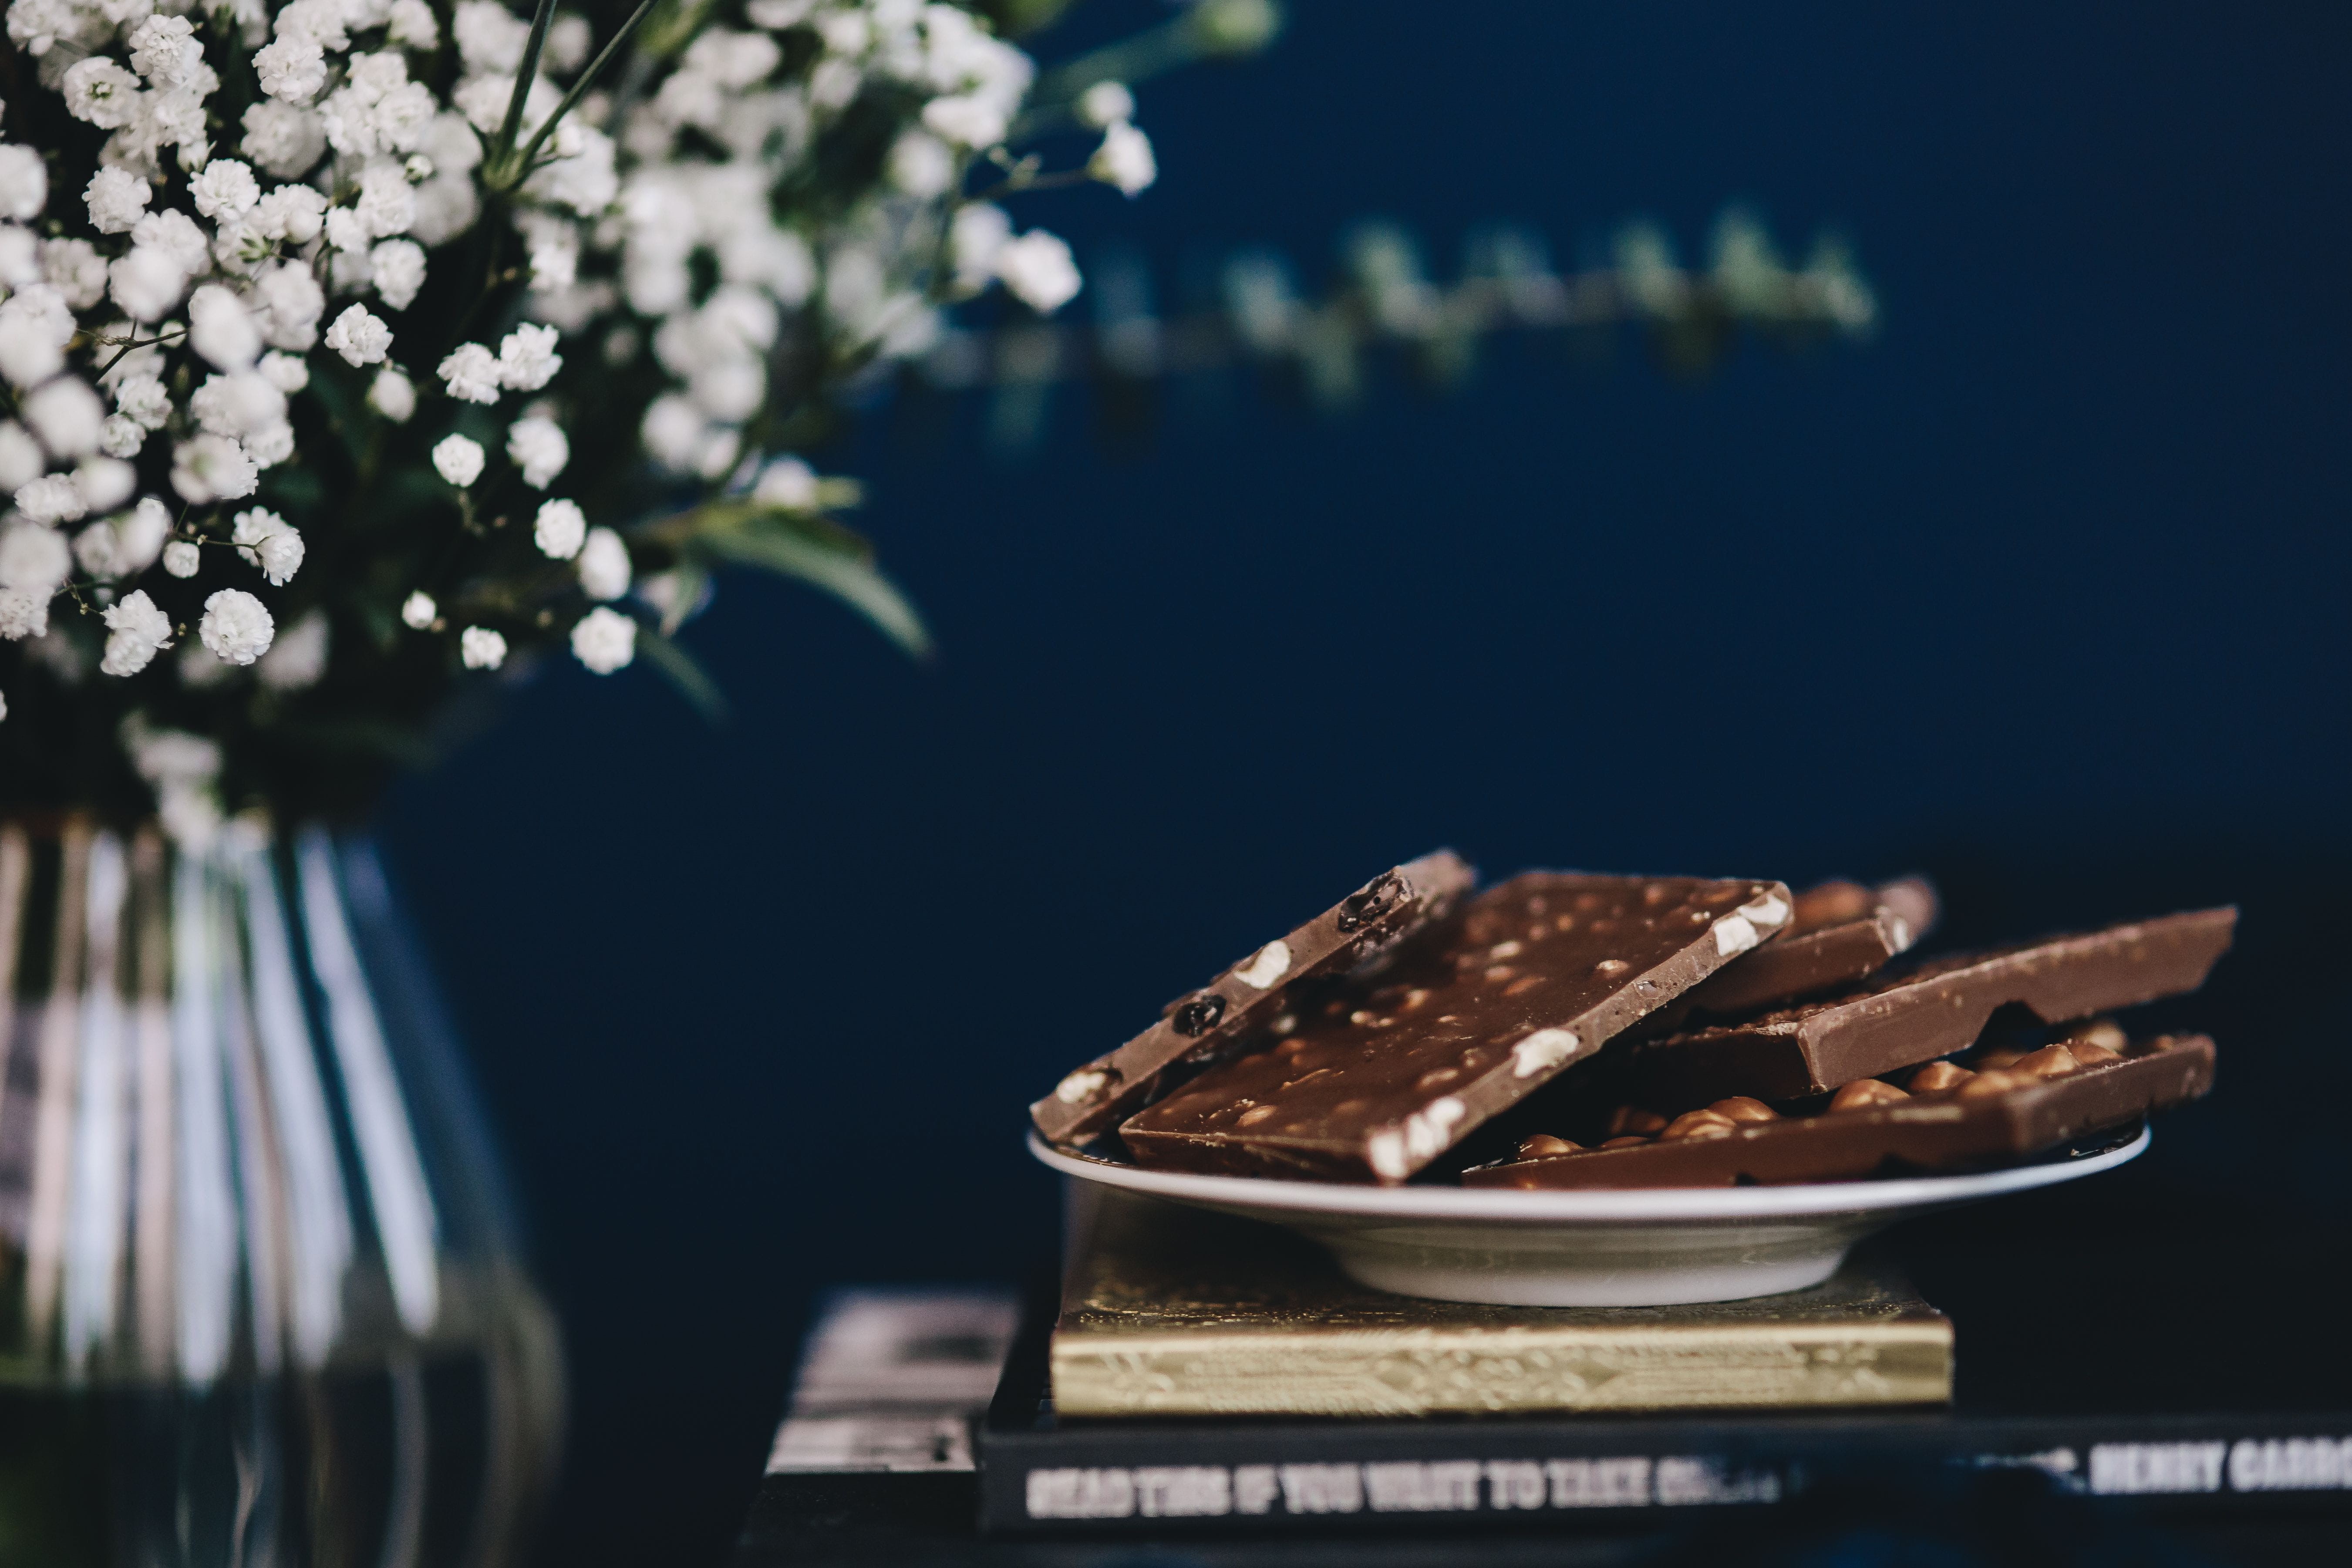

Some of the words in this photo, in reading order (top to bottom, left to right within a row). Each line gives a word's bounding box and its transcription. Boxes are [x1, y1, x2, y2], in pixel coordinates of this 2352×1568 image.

[1025, 1467, 1134, 1519] READ
[1281, 1462, 1364, 1514] YOU
[1365, 1460, 1480, 1512] WANT
[1486, 1460, 1547, 1510] TO
[1548, 1457, 1650, 1507] TAKE
[2090, 1442, 2225, 1494] HENRY
